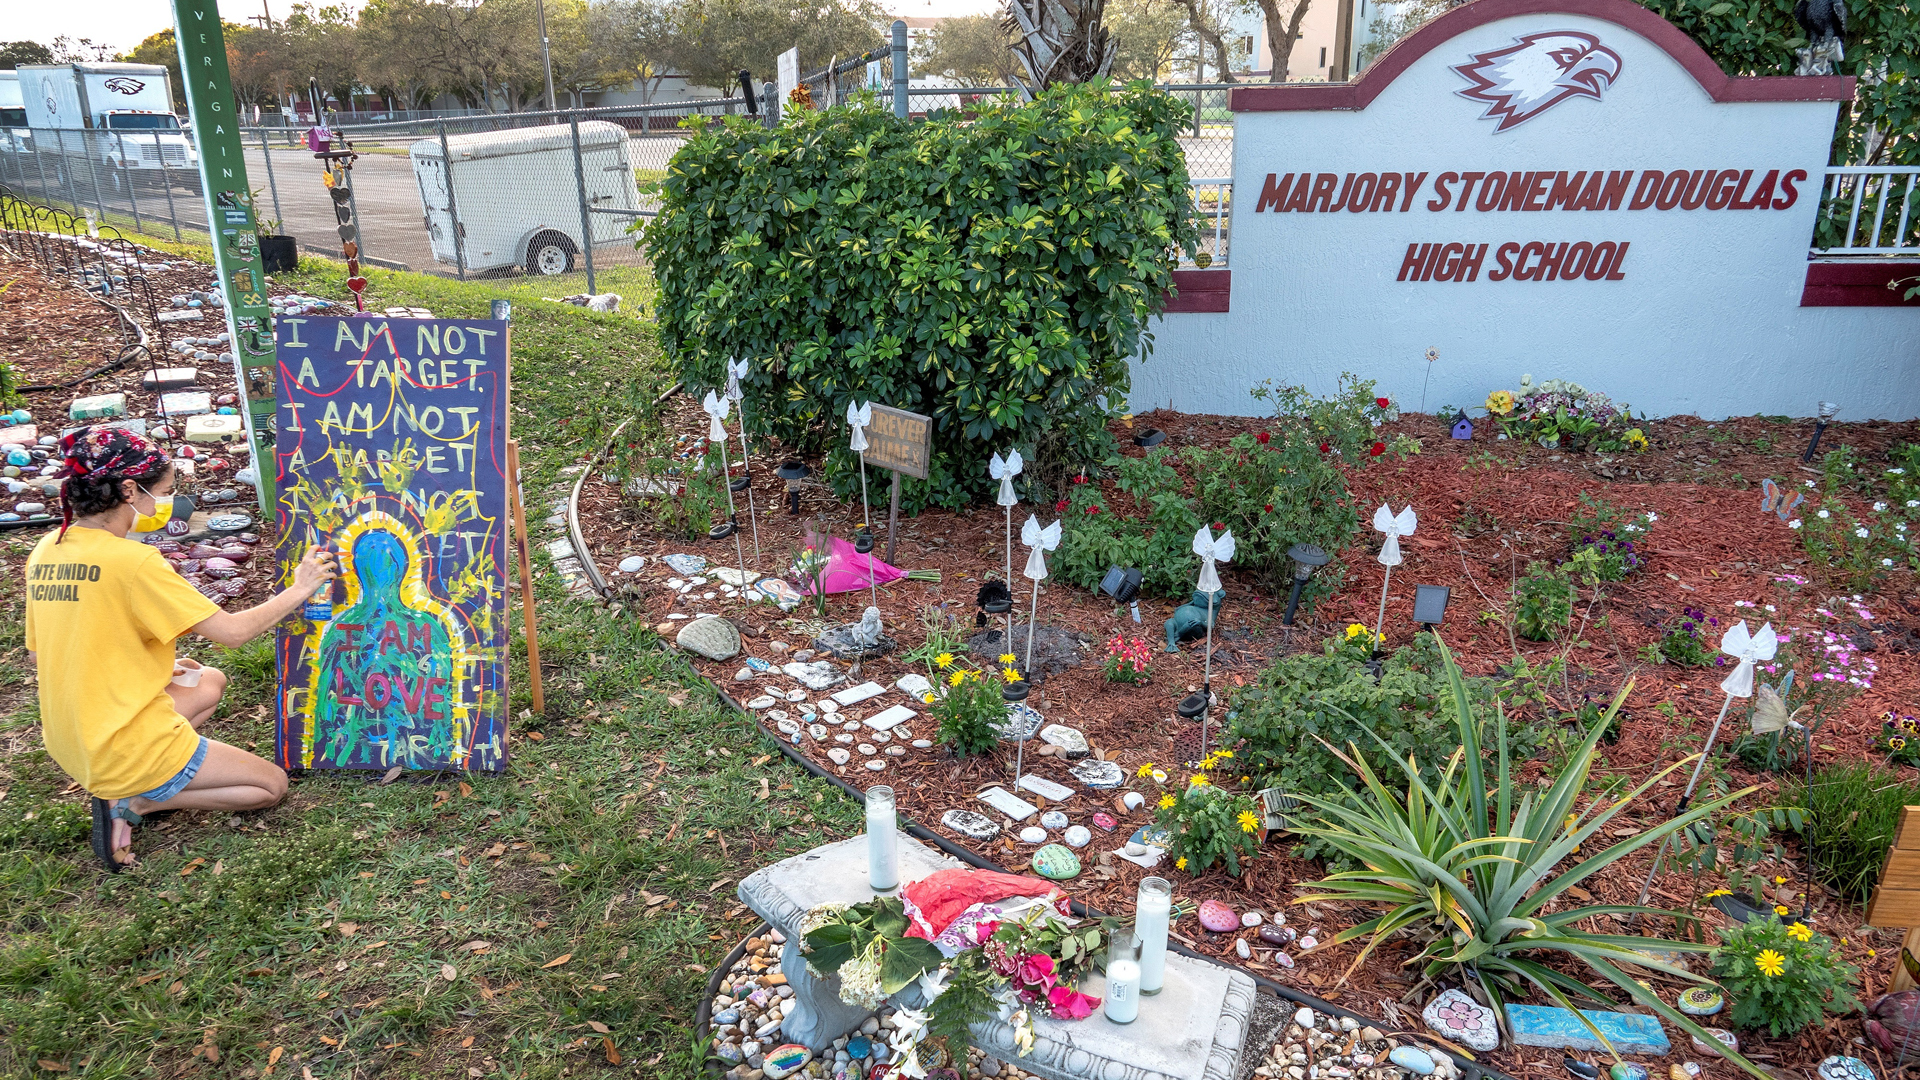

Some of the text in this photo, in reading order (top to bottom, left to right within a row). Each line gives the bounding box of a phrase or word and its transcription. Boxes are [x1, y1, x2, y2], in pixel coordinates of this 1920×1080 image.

[1255, 169, 1808, 214] MARJORY STONEMAN DOUGLAS
[1396, 241, 1631, 282] HIGH SCHOOL
[283, 318, 308, 348] I
[334, 320, 396, 355] AM
[417, 324, 498, 355] NOT
[296, 356, 488, 393] A TARGET.
[282, 400, 479, 440] I AM NOT
[288, 442, 475, 480] A TARGET
[325, 487, 377, 518] AM
[167, 520, 189, 535] MSD
[56, 563, 101, 582] UNIDO
[336, 620, 432, 656] I AM
[336, 667, 448, 721] LOVE
